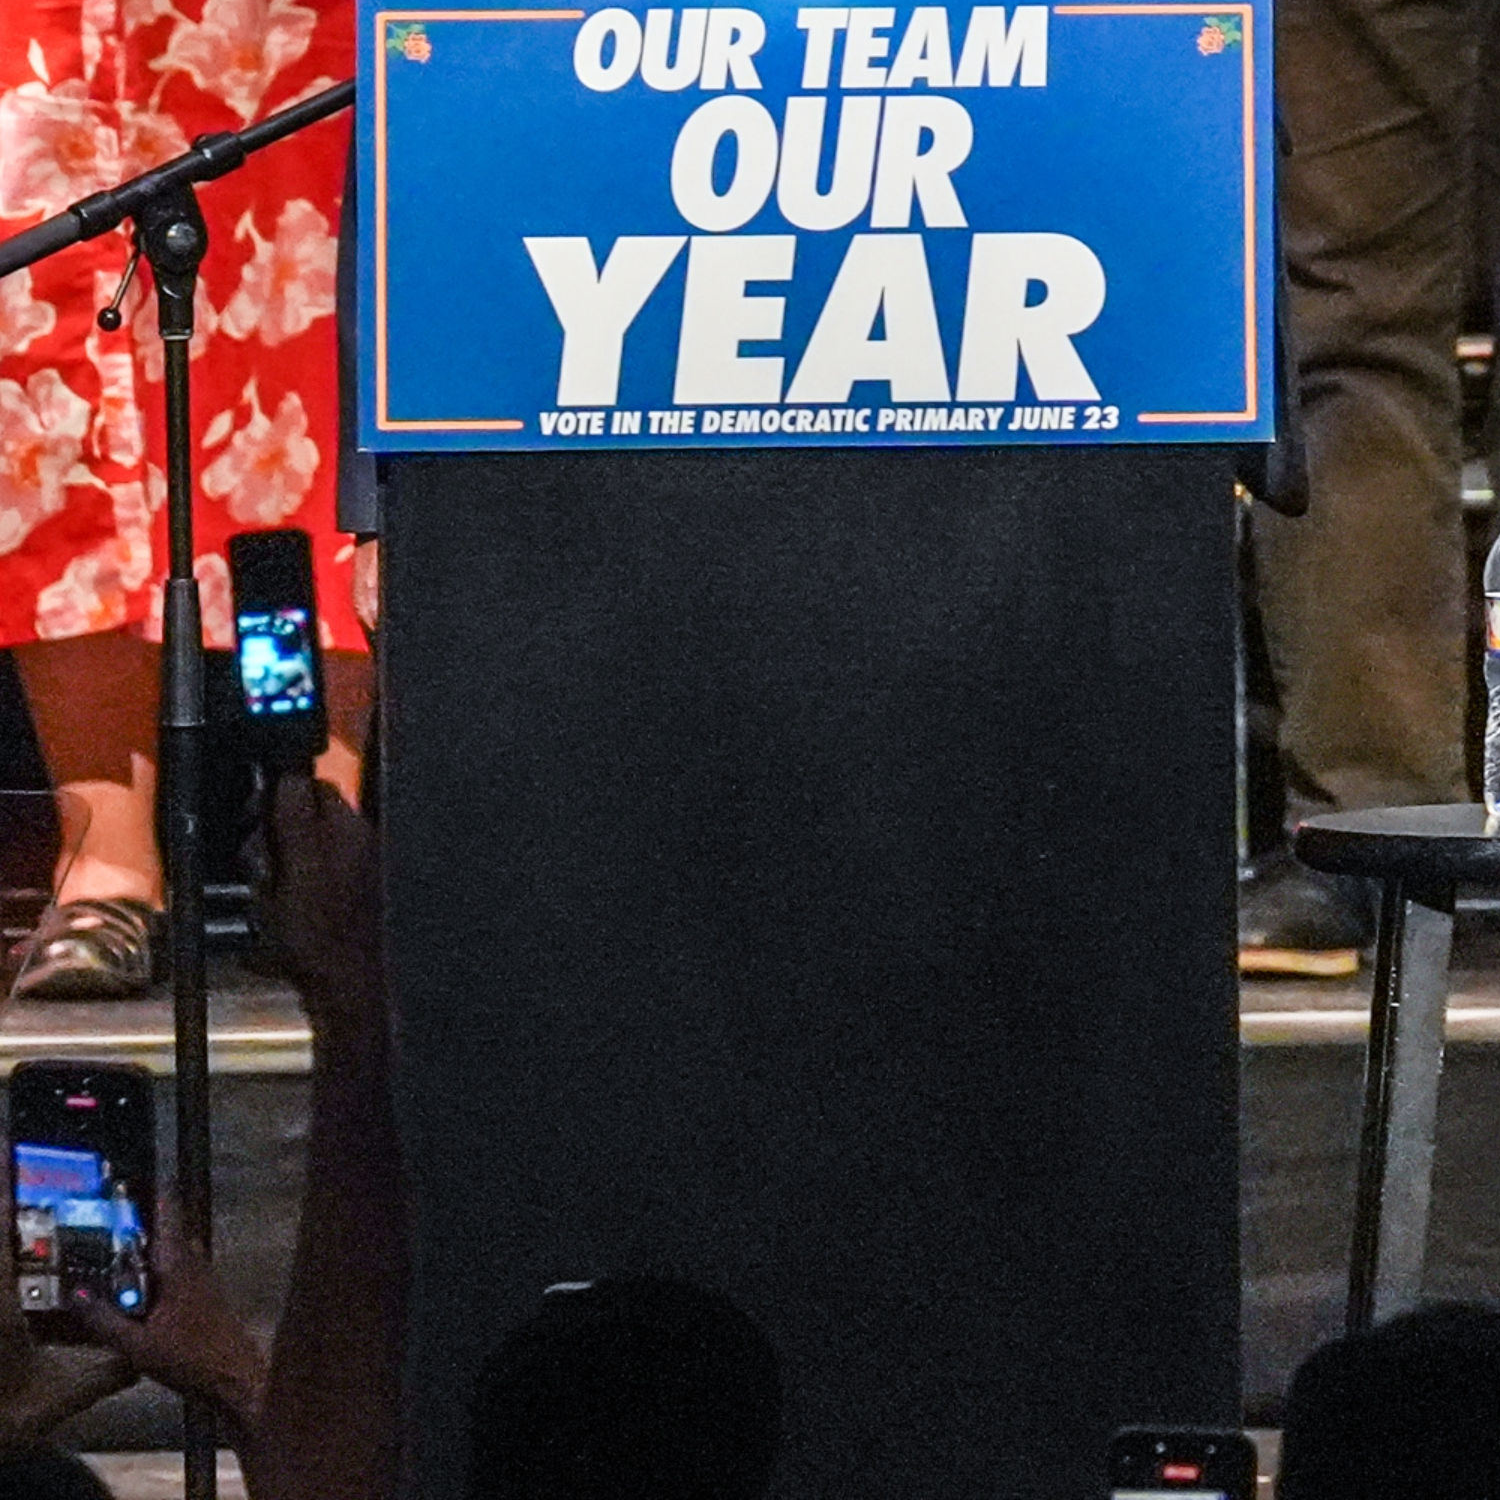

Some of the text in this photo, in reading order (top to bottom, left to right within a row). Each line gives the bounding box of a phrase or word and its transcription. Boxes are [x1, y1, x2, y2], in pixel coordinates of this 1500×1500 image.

[572, 5, 1049, 93] OUR TEAM
[670, 95, 975, 232] OUR
[523, 232, 1107, 407] YEAR
[539, 406, 1120, 436] VOTE IN THE DEMOCRATIC PRIMARY JUNE 23
